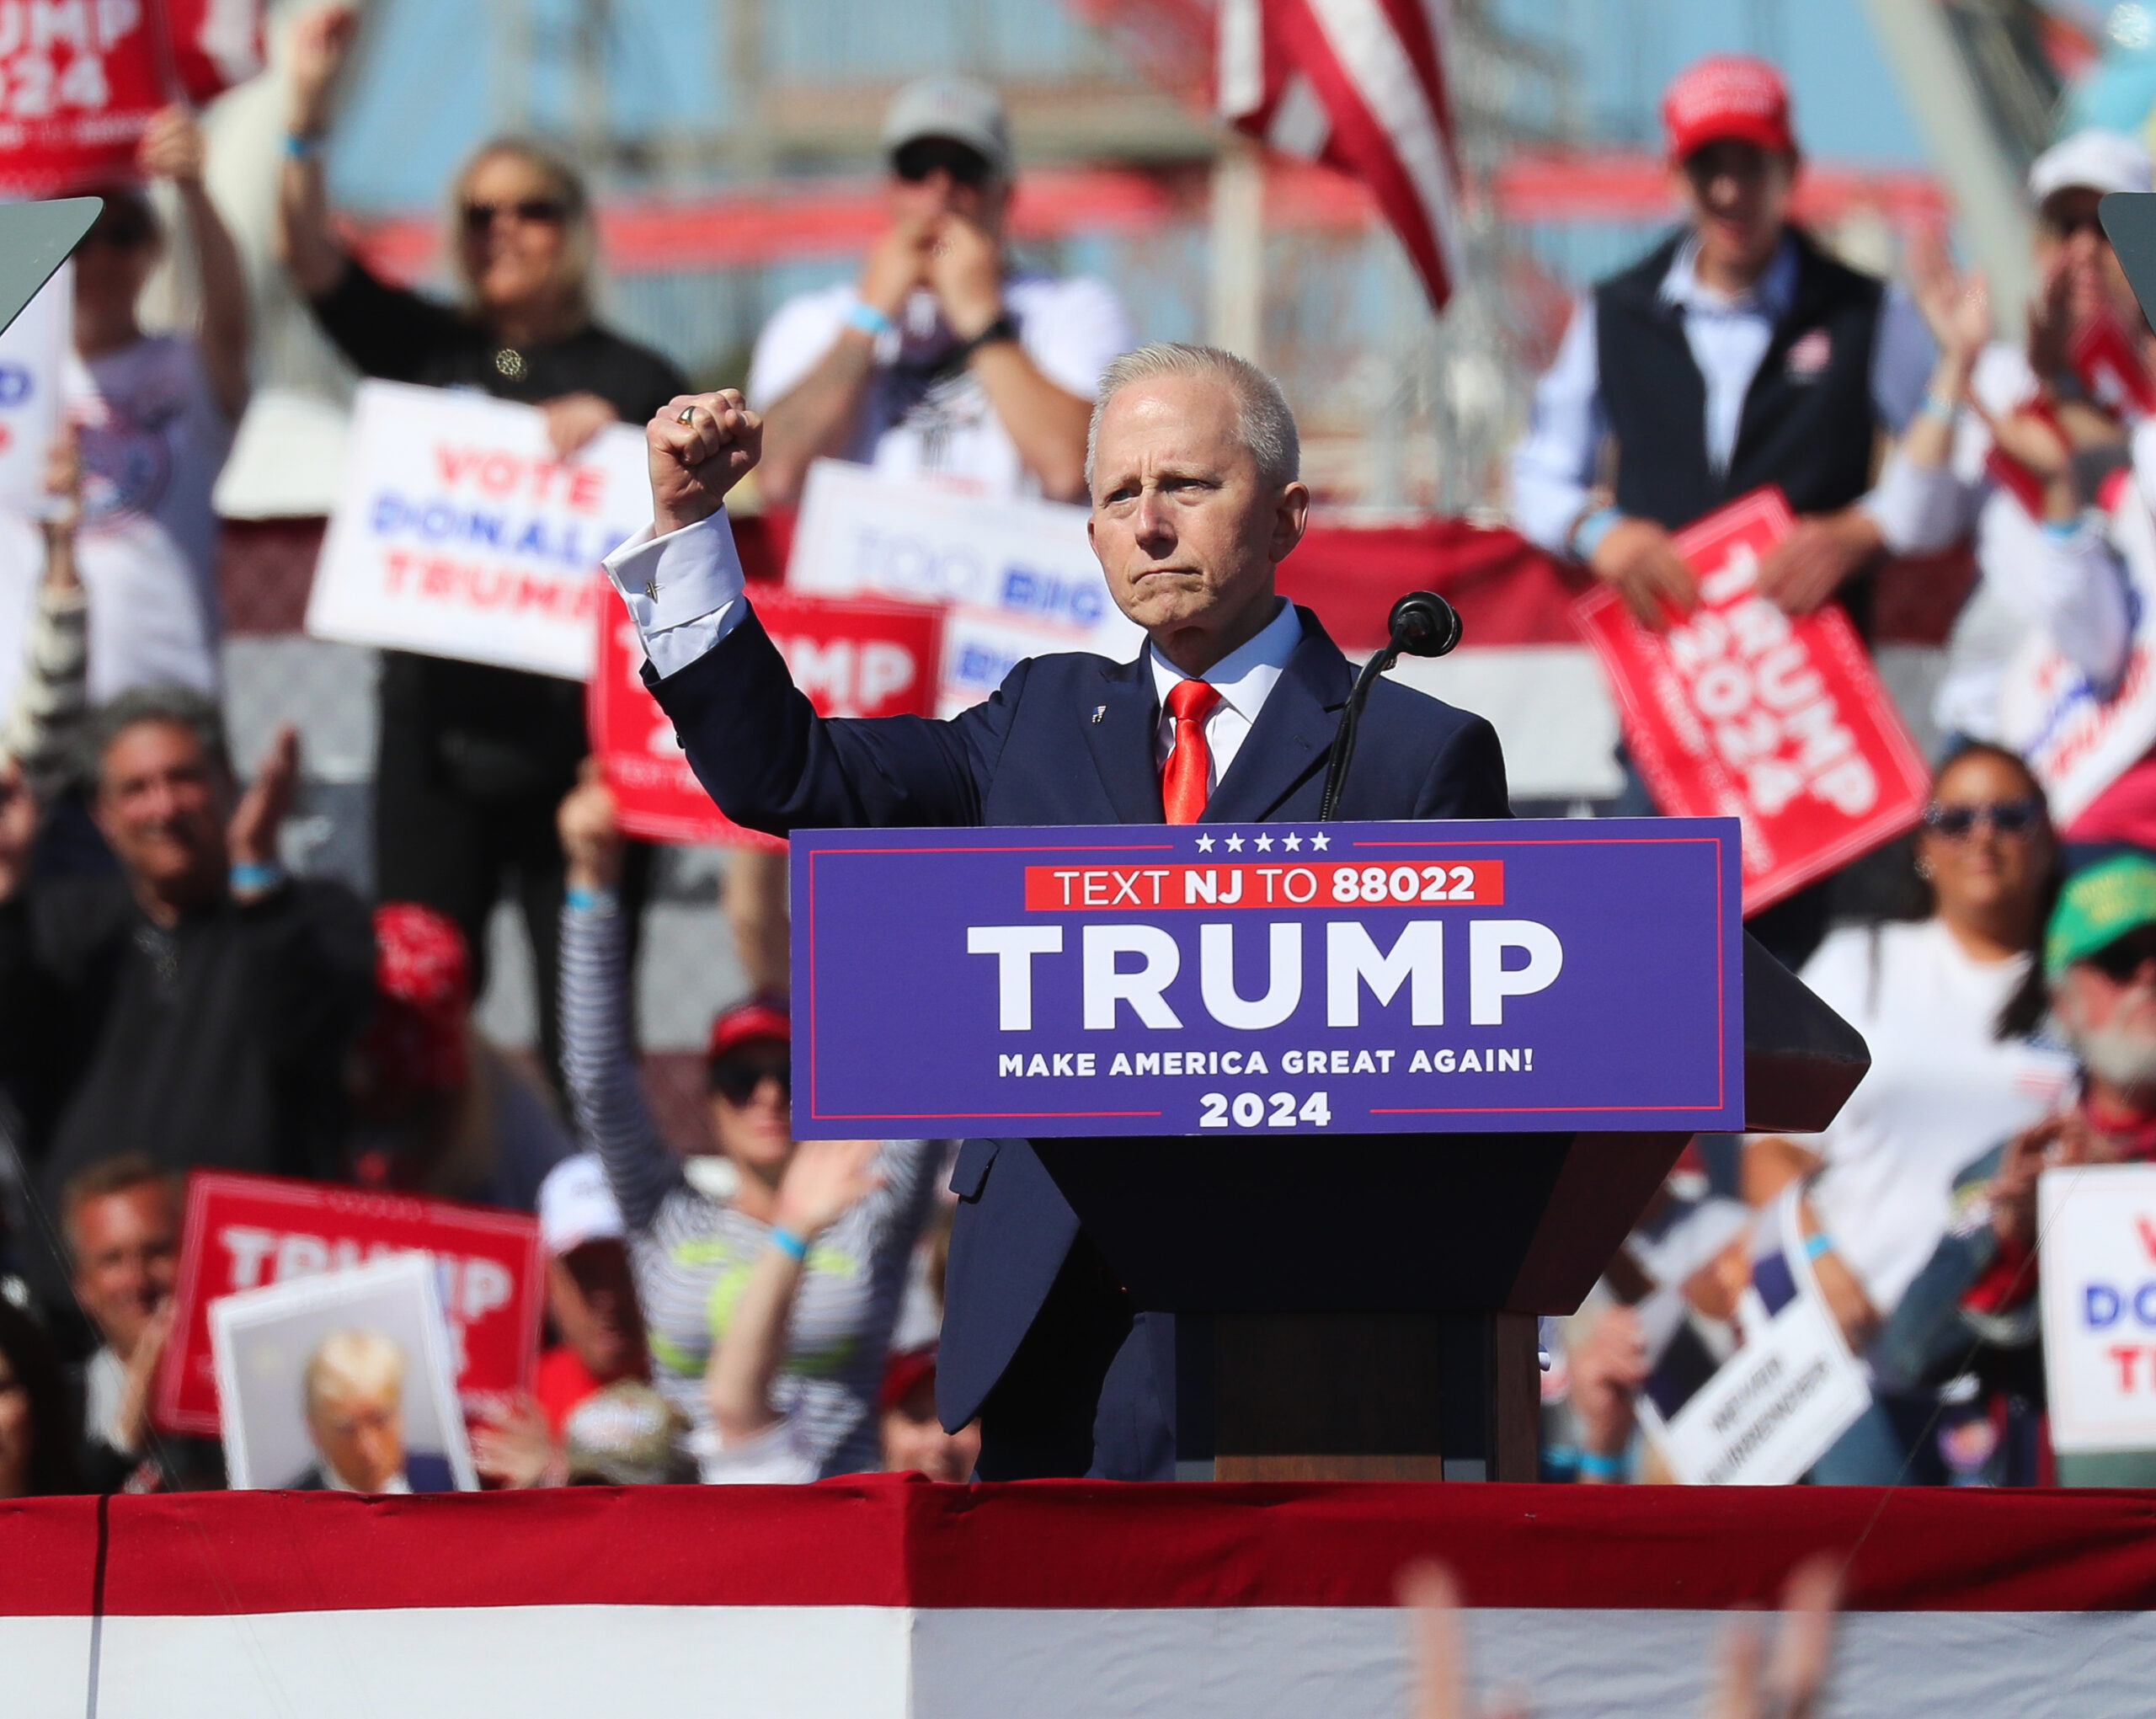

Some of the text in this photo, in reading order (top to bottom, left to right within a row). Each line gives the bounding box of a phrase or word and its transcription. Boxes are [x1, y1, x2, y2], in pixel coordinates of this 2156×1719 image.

[0, 51, 108, 116] 24
[435, 440, 605, 513] VOTE
[616, 620, 915, 718] TMP
[1699, 540, 1880, 817] TRUMP
[1667, 611, 1806, 817] 2024
[1054, 866, 1475, 905] TEXT NJ TO 88022
[967, 920, 1563, 1031] TRUMP
[999, 1048, 1533, 1077] MAKE AMERICA GREAT AGAIN!
[1199, 1092, 1331, 1128] 2024
[221, 1225, 512, 1321] TRP
[2108, 1345, 2156, 1391] T
